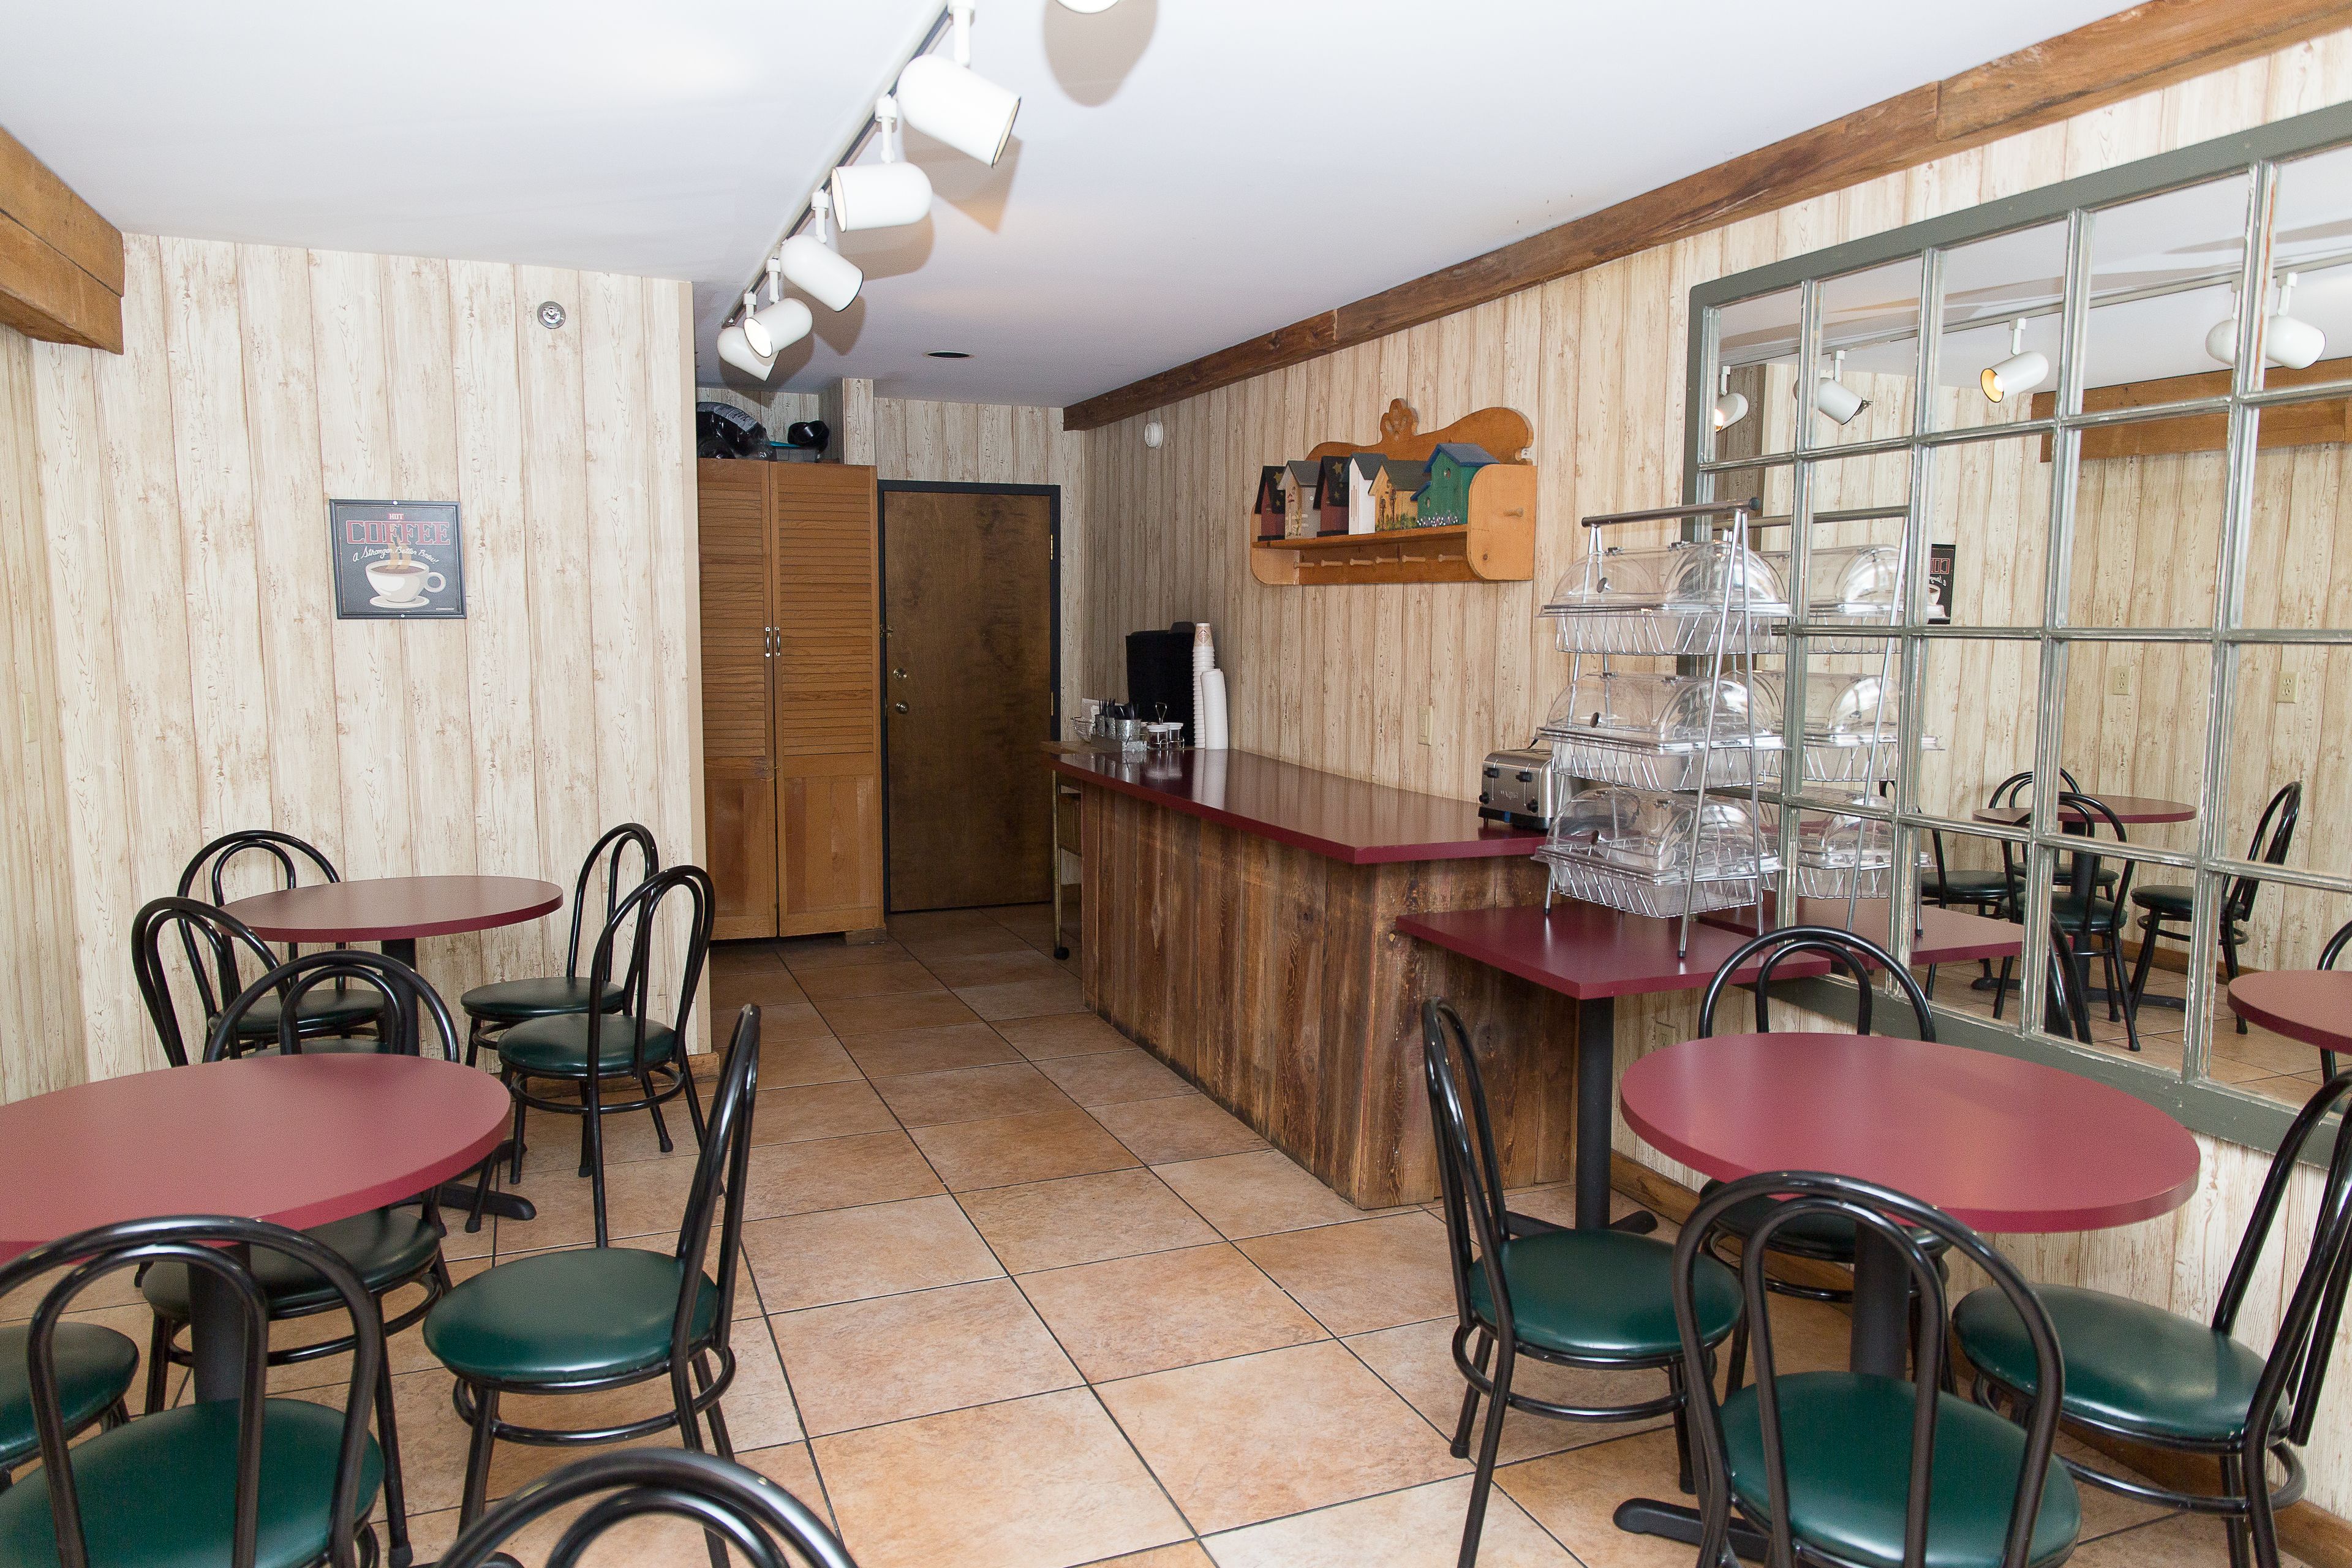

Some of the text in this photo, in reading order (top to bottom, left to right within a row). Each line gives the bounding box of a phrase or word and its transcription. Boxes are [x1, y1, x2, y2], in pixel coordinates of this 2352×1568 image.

[345, 520, 451, 545] COFFEE
[395, 546, 418, 555] Better
[418, 549, 439, 564] Brew!
